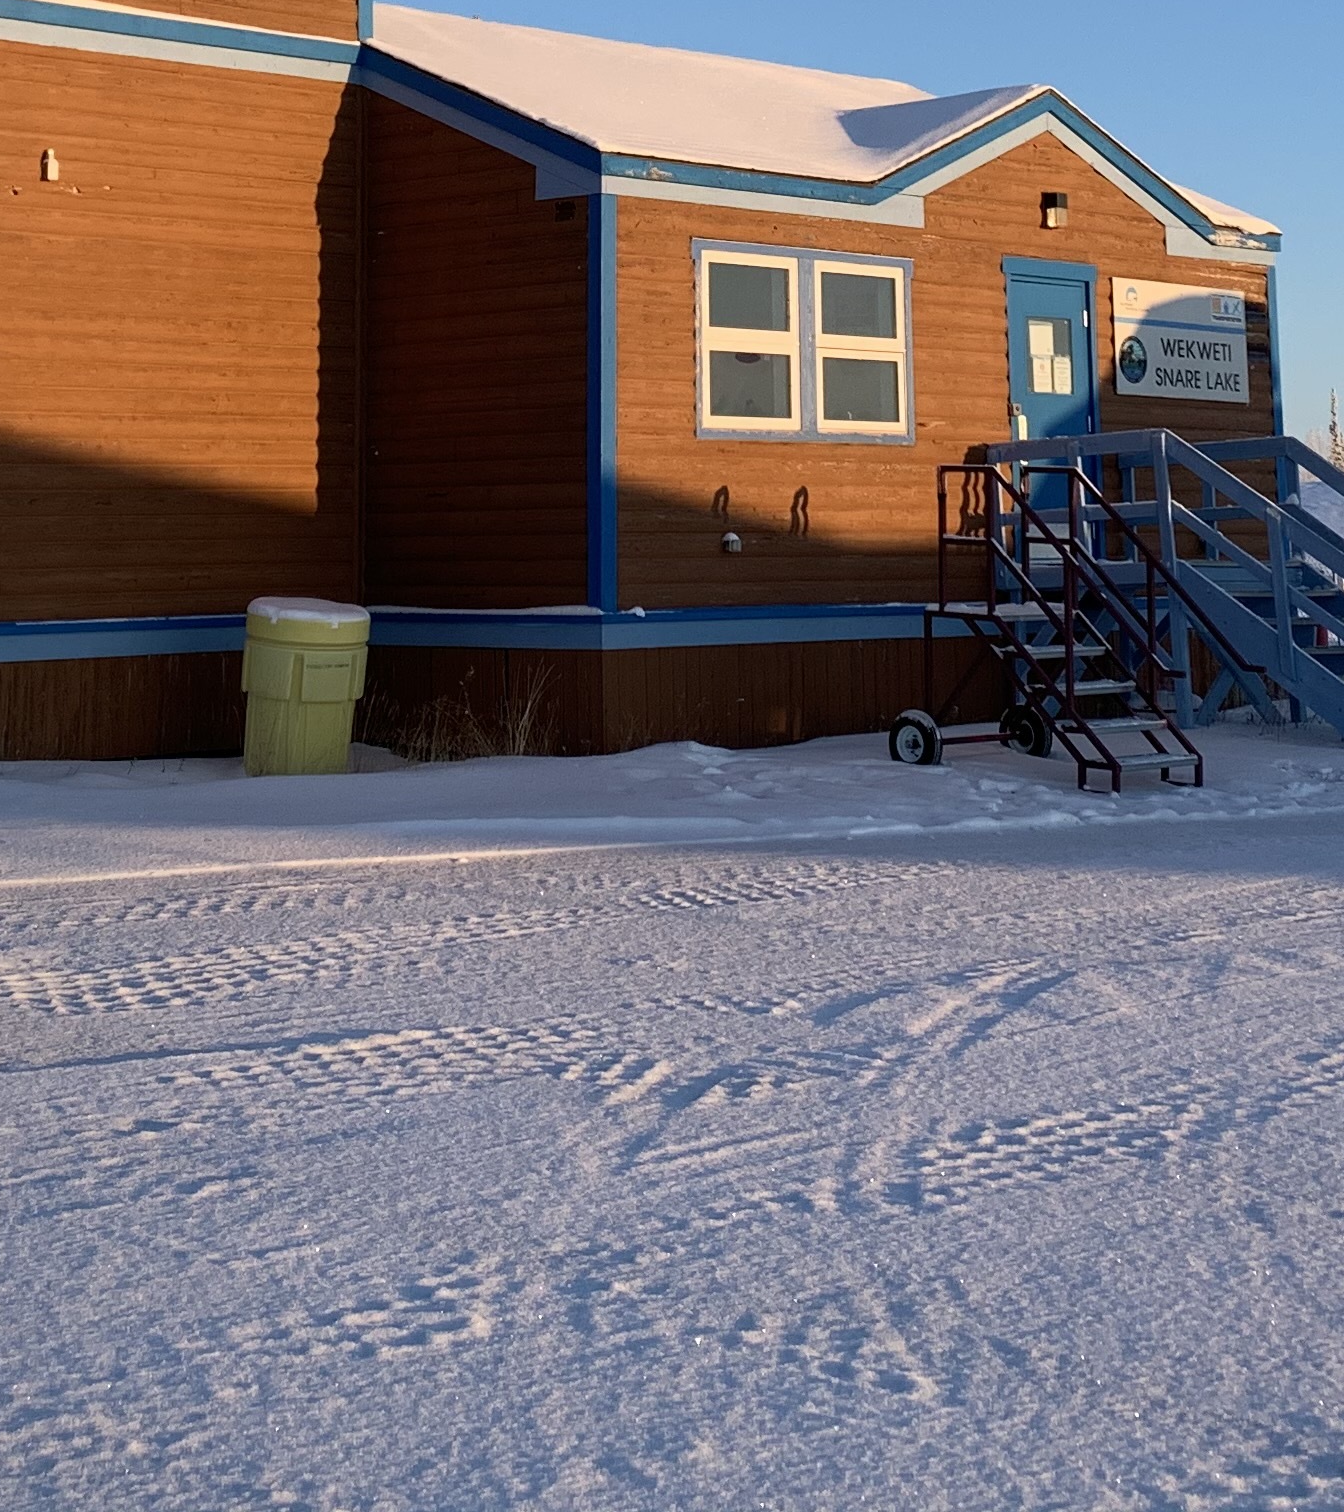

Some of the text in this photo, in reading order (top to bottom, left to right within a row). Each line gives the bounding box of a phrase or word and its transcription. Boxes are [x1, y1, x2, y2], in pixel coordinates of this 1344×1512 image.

[1160, 337, 1232, 363] WEKWETI
[1155, 367, 1241, 392] SNARE LAKE
